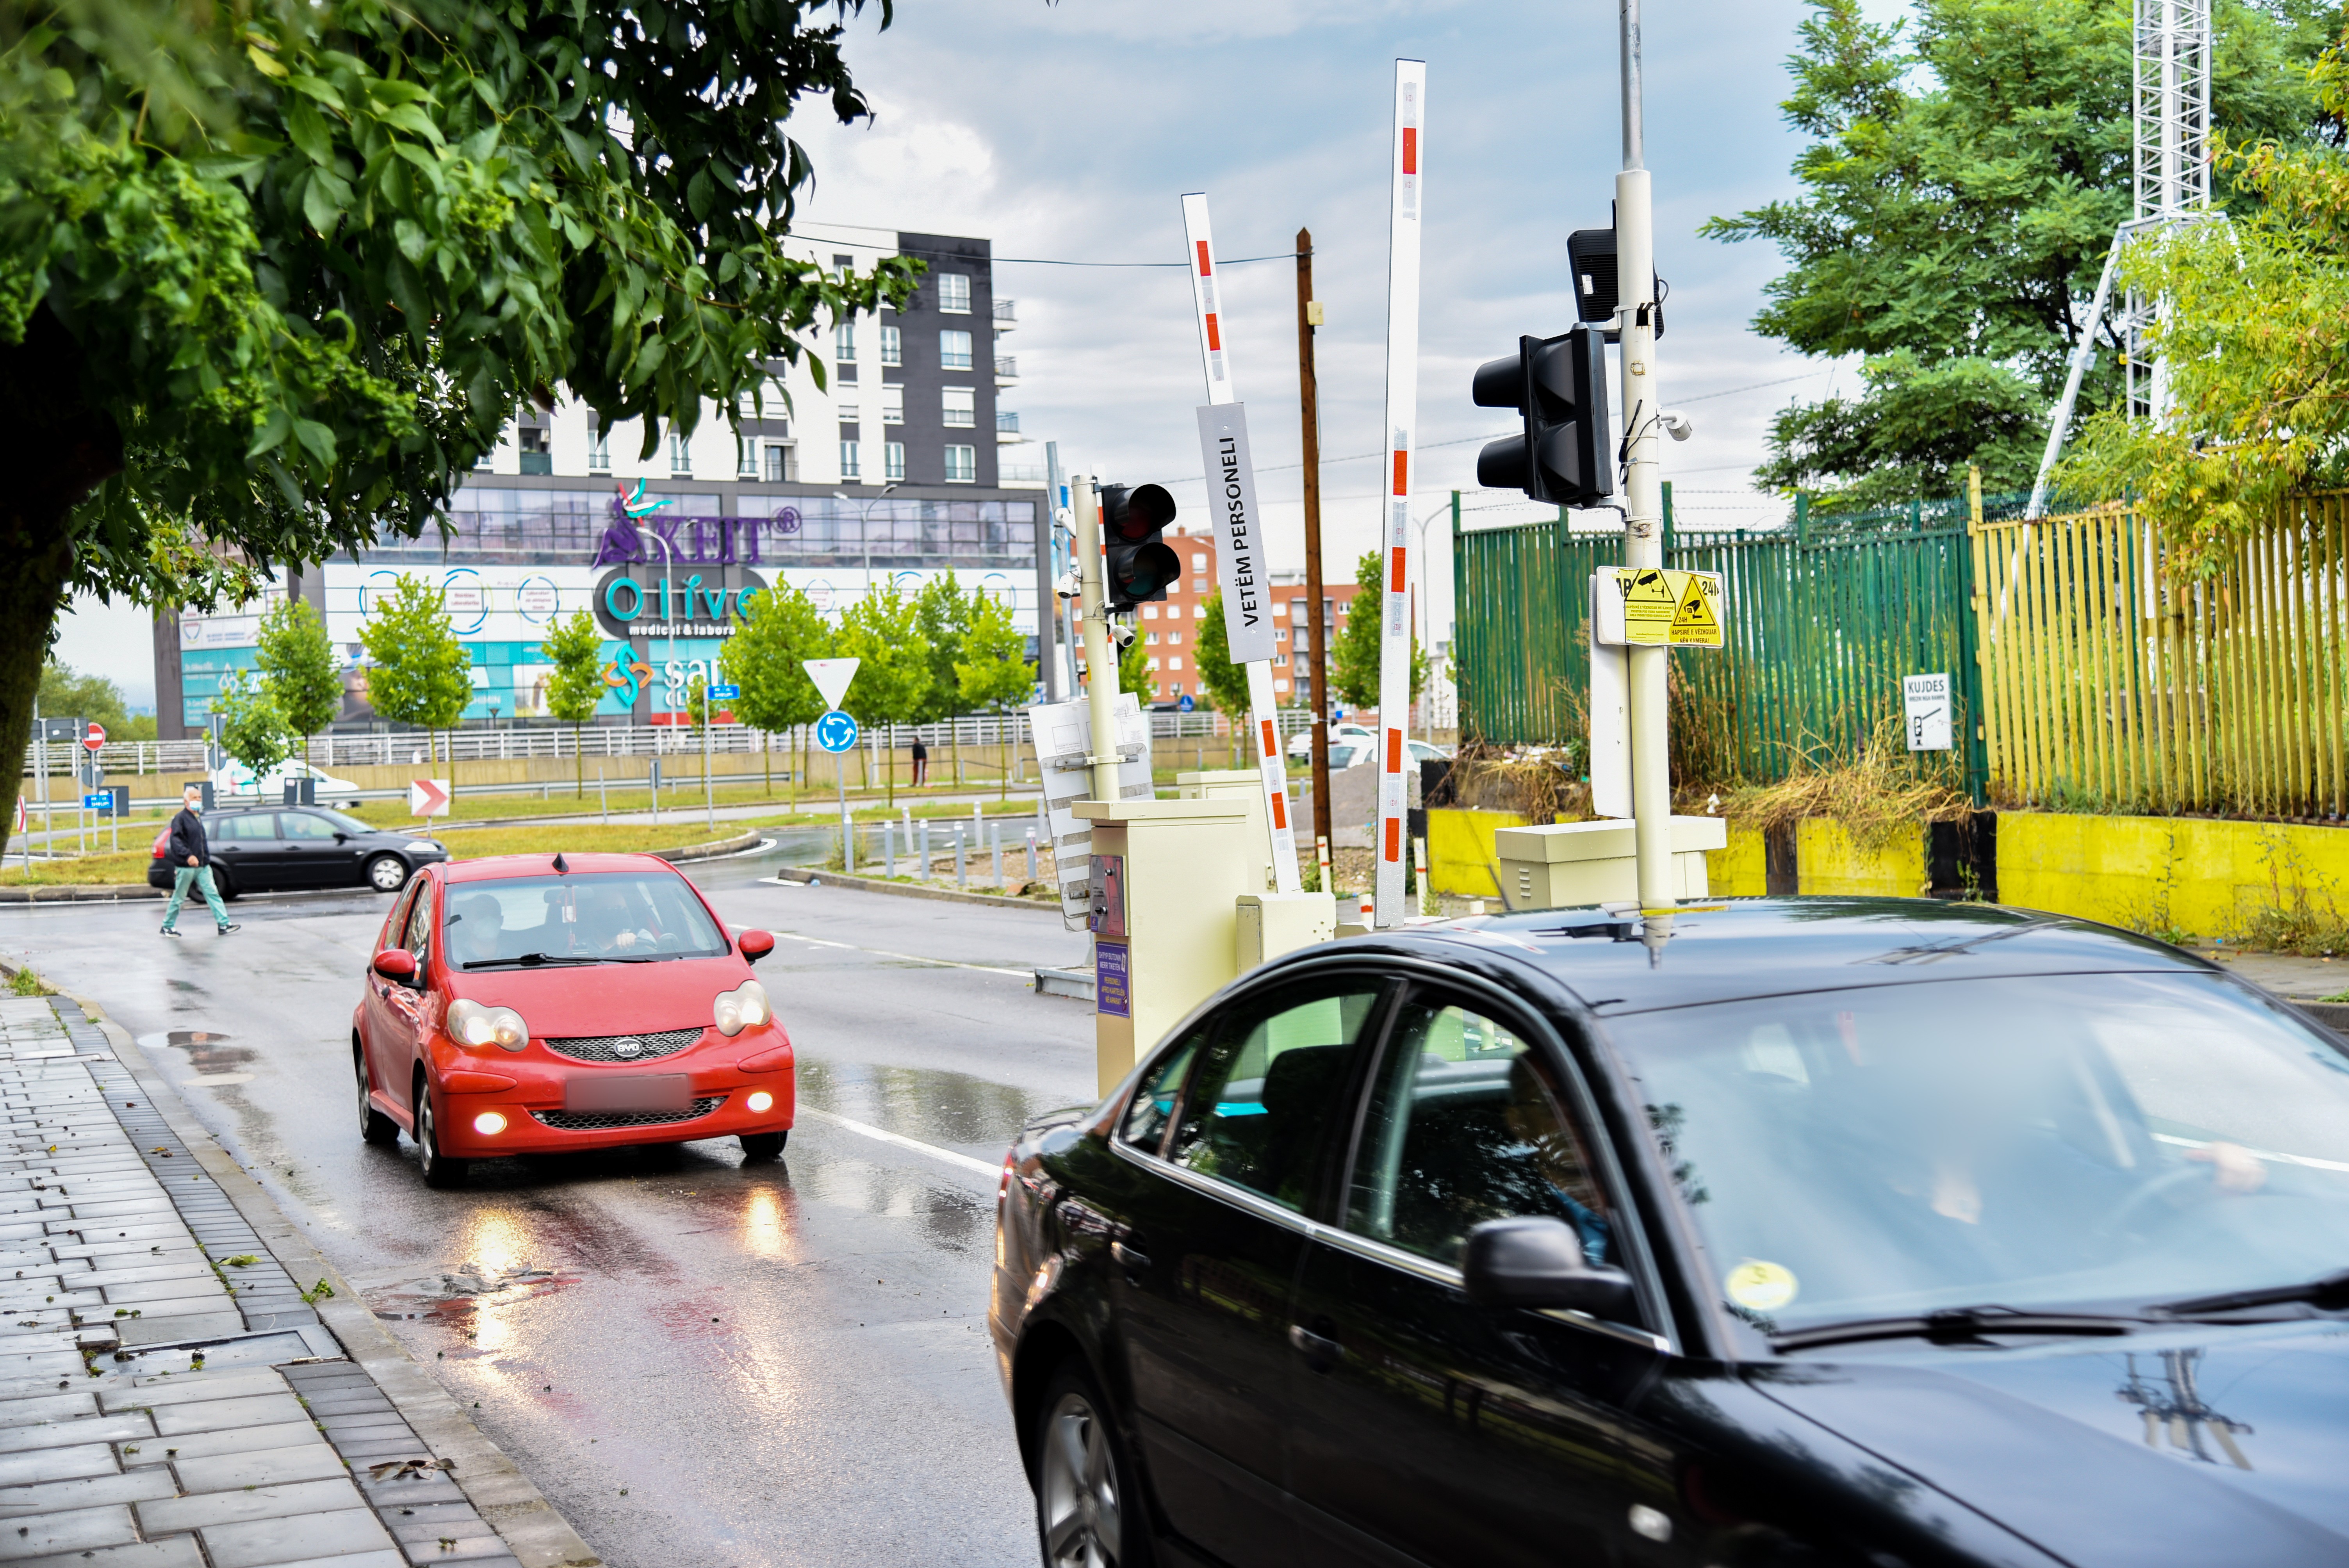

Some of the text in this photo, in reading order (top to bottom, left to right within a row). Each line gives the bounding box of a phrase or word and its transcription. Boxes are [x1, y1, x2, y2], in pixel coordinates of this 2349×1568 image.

[1219, 437, 1259, 627] VETËM PERSONELI
[683, 624, 692, 635] &
[694, 624, 736, 635] labora
[1908, 679, 1944, 693] KUJDES
[617, 1043, 639, 1052] BYD
